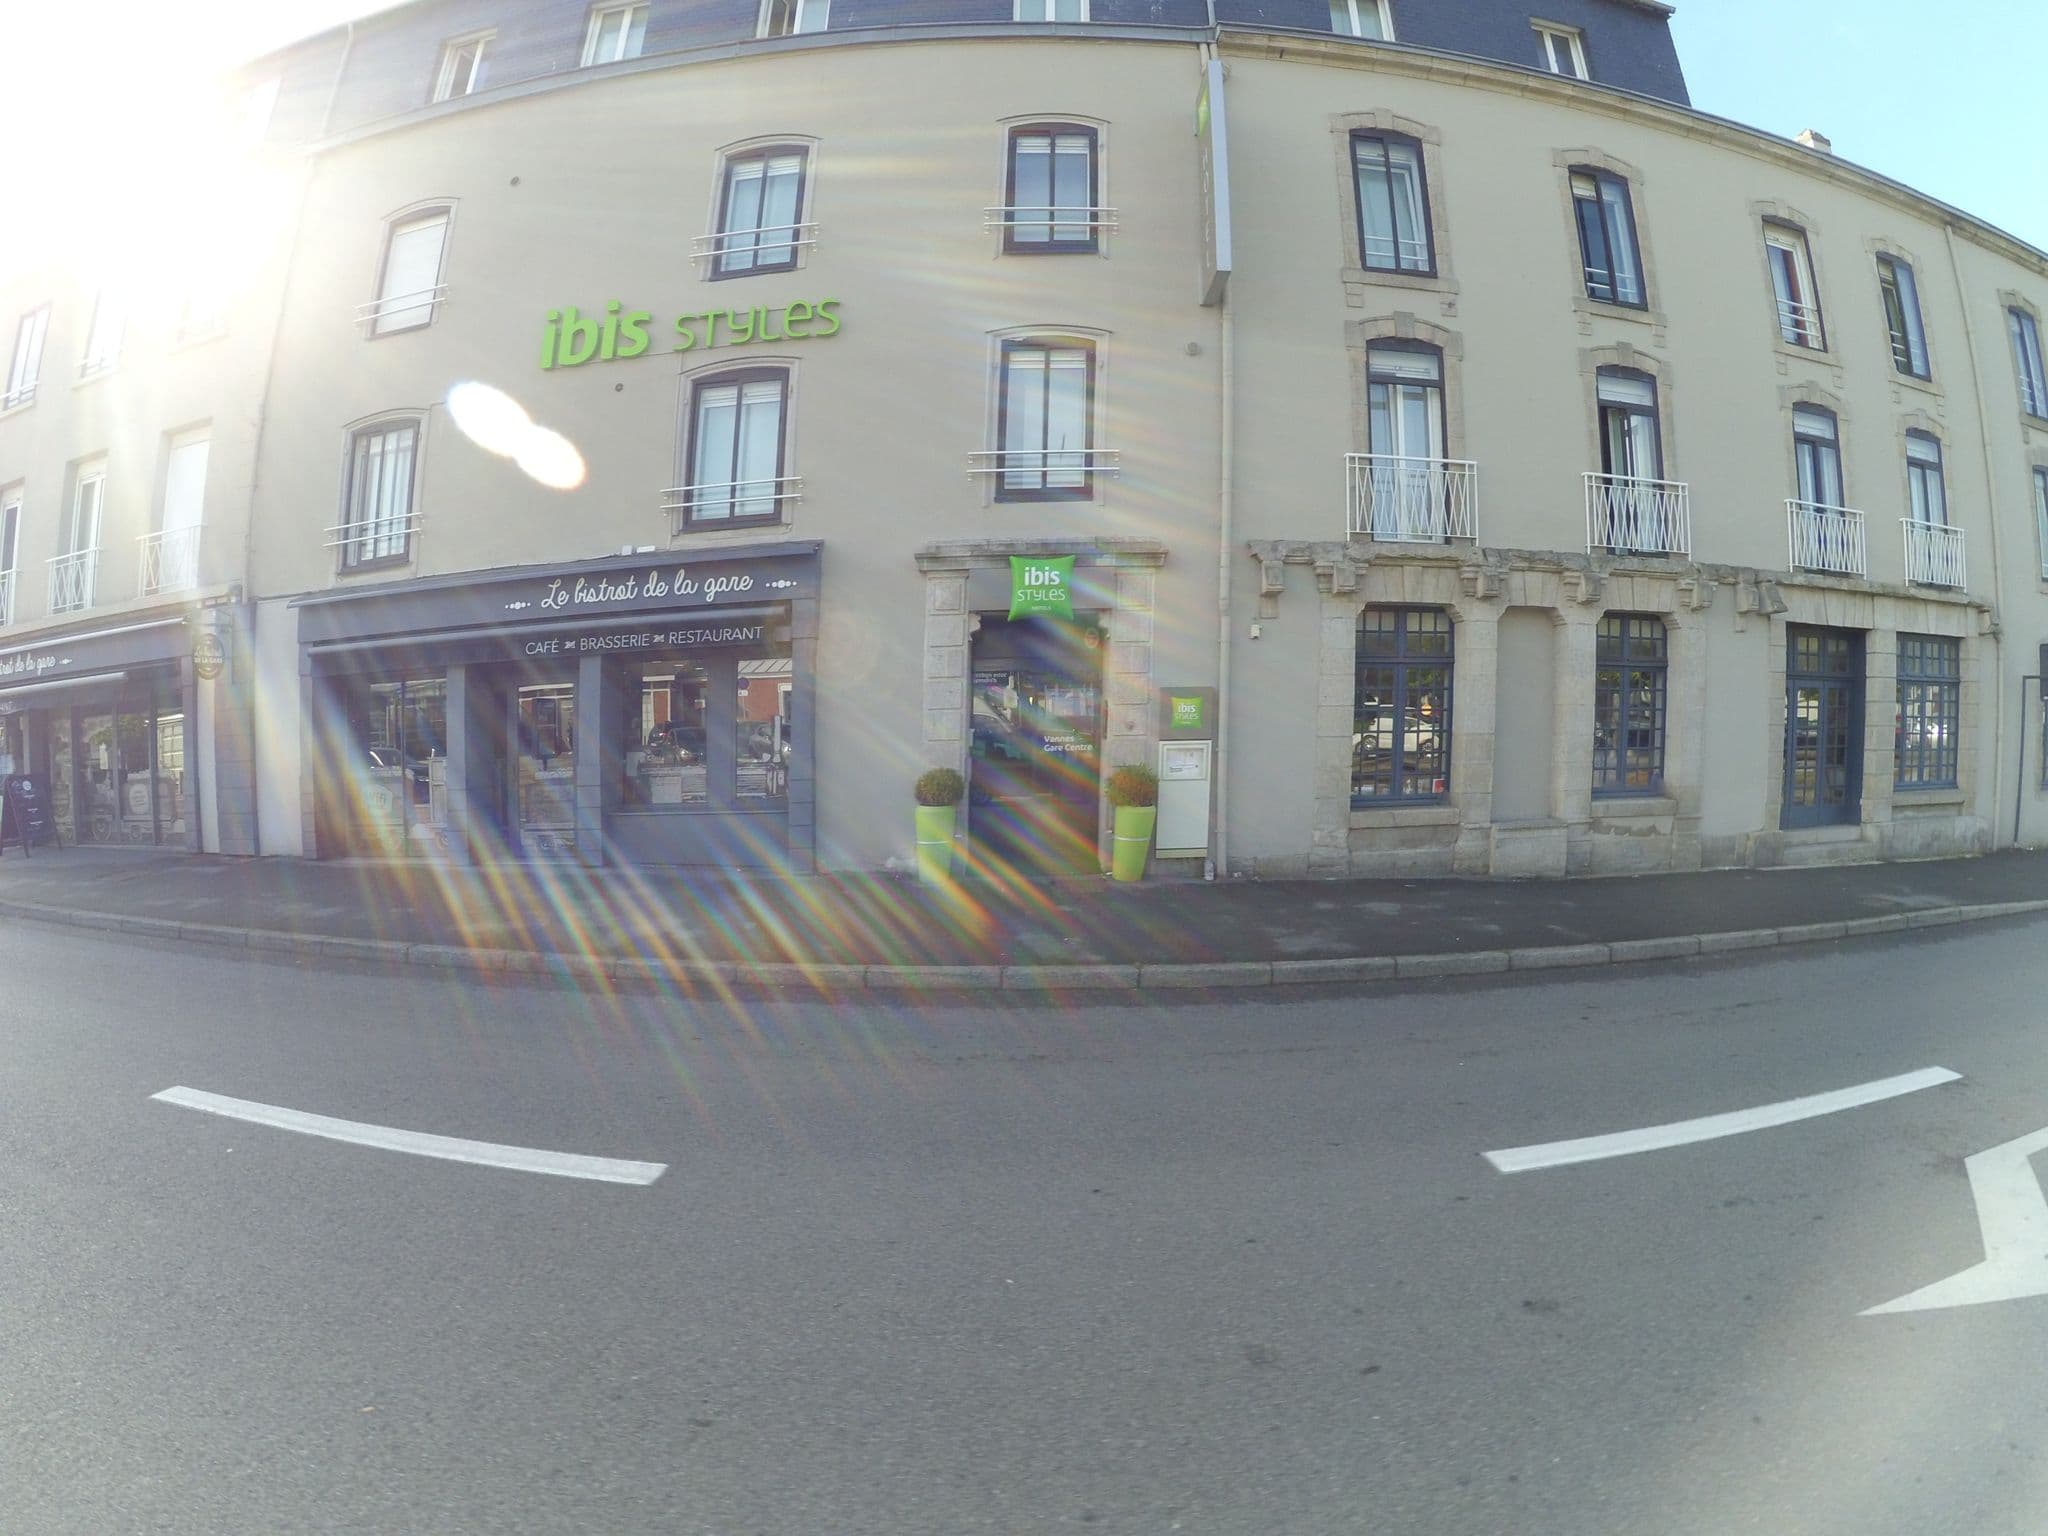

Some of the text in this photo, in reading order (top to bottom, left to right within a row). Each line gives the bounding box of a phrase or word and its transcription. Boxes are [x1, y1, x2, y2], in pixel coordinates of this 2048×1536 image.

[540, 299, 652, 370] ibis
[1024, 566, 1061, 586] ibis
[541, 568, 753, 609] Le bistrot de la gare
[525, 626, 763, 656] CAFÉ BRASSERIE RESTAURANT
[1178, 702, 1197, 713] ibis
[1043, 735, 1074, 743] Vannes
[1043, 743, 1094, 752] Gare Centre
